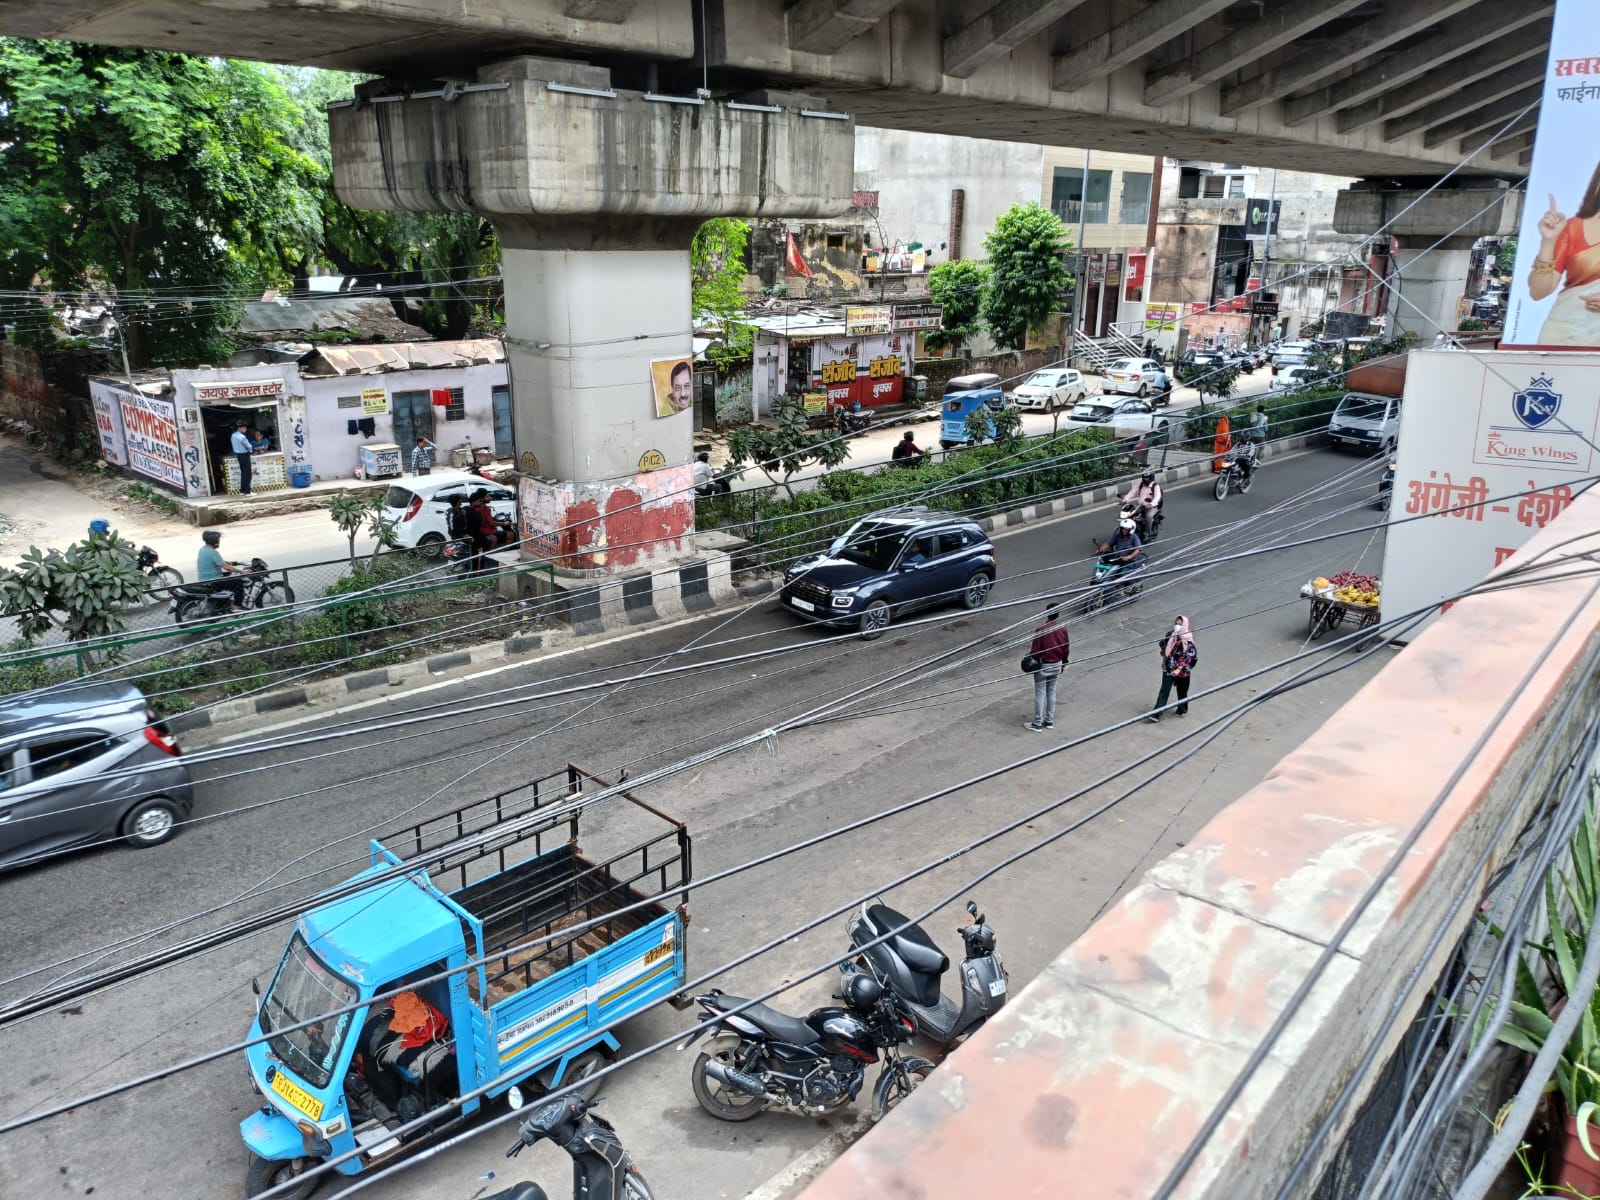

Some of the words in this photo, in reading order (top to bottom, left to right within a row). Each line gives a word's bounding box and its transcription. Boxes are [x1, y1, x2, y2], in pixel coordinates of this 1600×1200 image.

[822, 360, 857, 384] संजीव
[870, 355, 902, 379] संजीव
[199, 387, 229, 399] जयपुर
[231, 385, 261, 397] जनरल
[262, 382, 283, 394] स्टोर
[827, 387, 850, 404] बुक्स
[872, 382, 893, 398] बुक्स
[122, 404, 177, 446] COMMERCE
[141, 437, 175, 461] CLASSES
[1486, 440, 1526, 458] King
[1532, 446, 1579, 461] Wines
